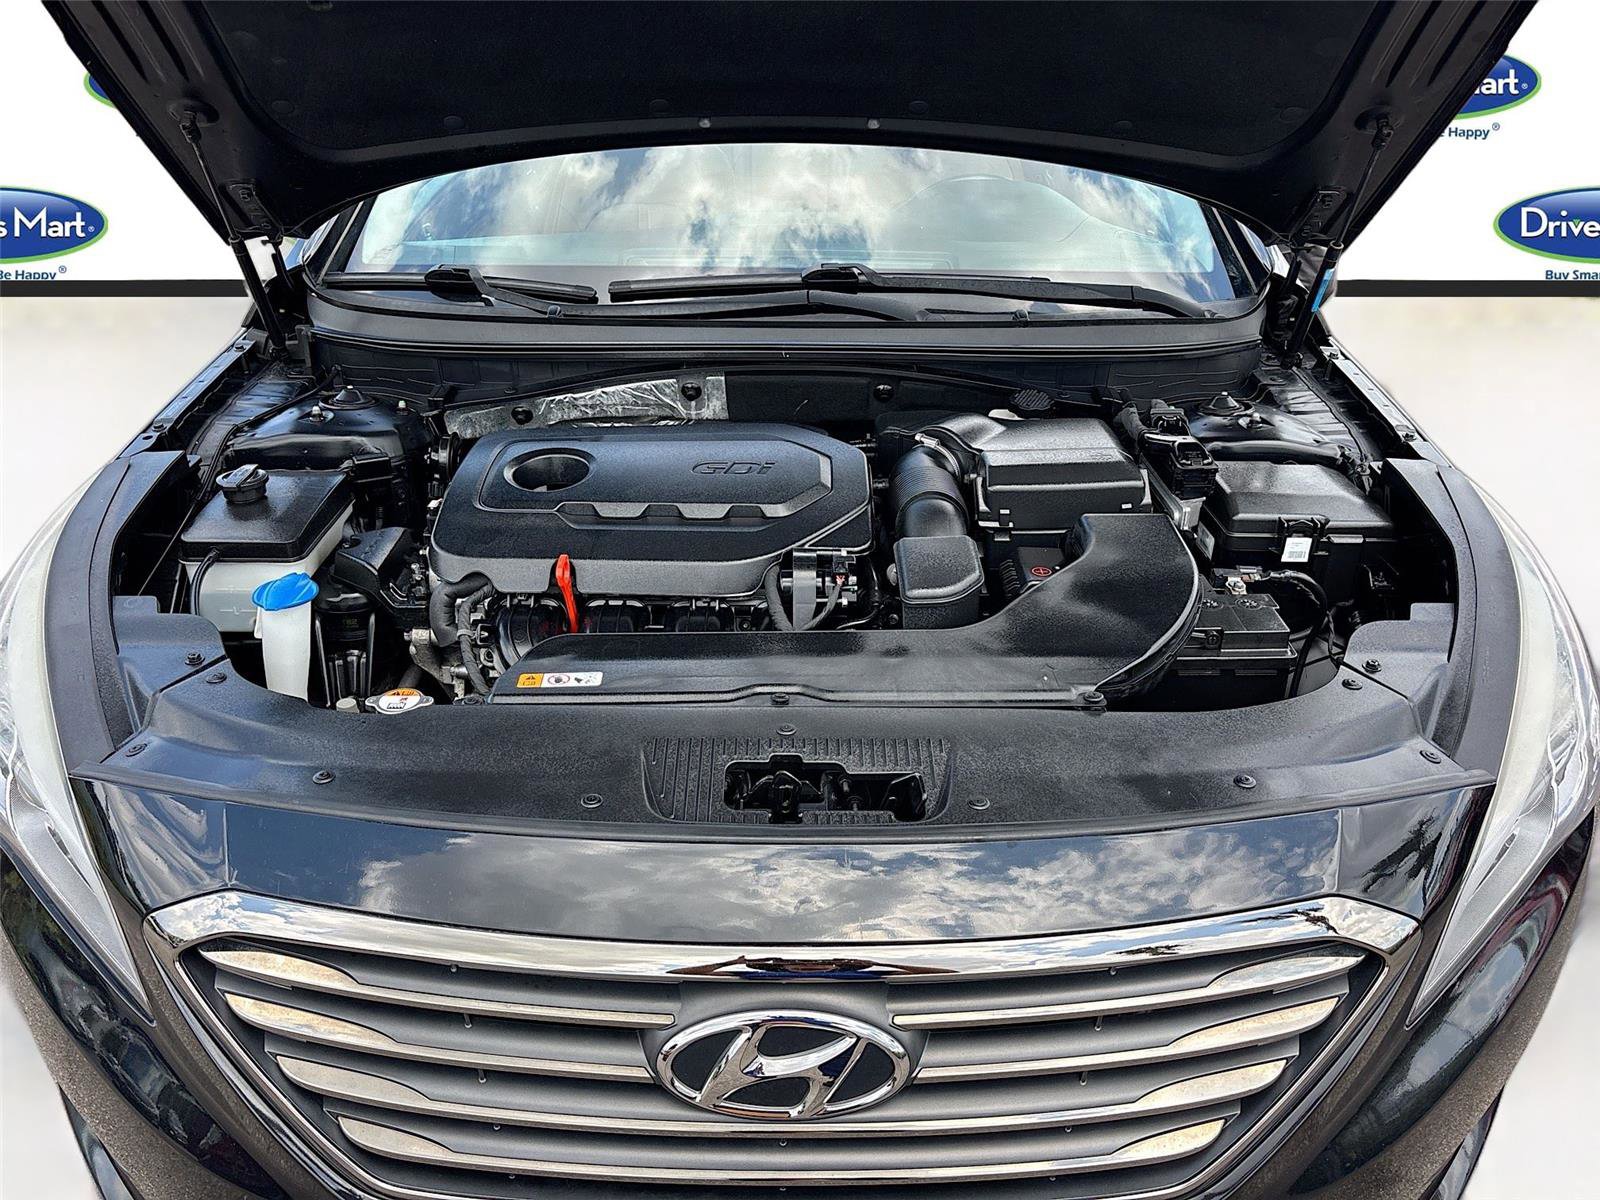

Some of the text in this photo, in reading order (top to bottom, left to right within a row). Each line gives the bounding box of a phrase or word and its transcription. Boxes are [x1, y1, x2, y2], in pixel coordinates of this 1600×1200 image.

[1474, 69, 1519, 94] art
[1448, 127, 1490, 139] Happy
[13, 206, 86, 238] Mart
